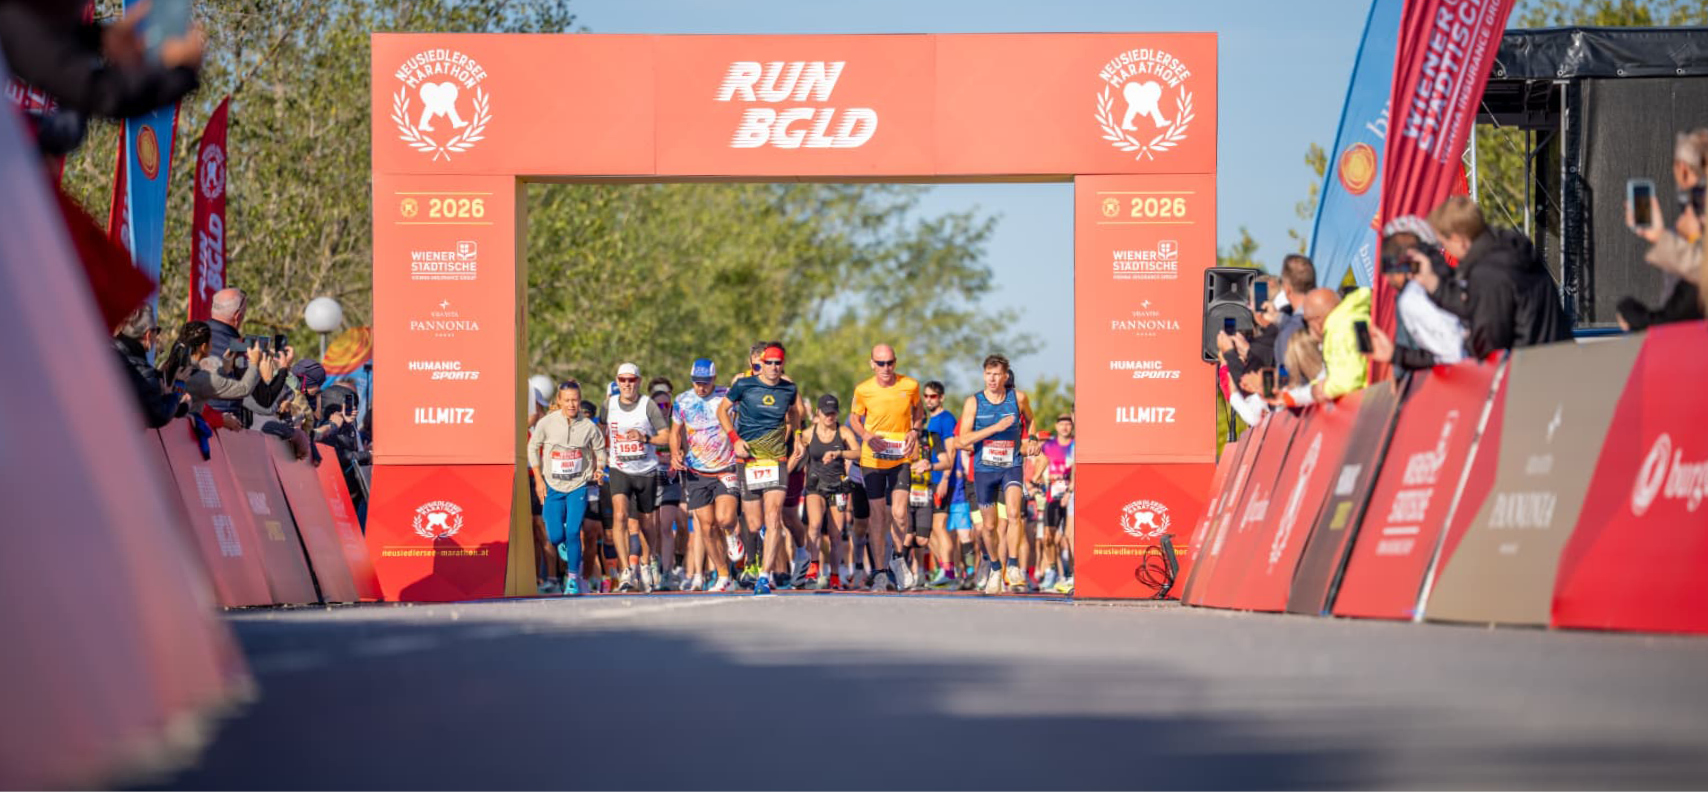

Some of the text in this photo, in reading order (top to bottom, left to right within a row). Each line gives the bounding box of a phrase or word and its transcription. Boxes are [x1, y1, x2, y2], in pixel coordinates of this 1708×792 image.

[395, 48, 488, 82] NEUSIEDLERSEE
[1099, 48, 1191, 82] NEUSIEDLERSEE
[1403, 5, 1453, 138] WIENER
[1457, 28, 1491, 111] INSURANCE
[406, 62, 477, 90] MARATHON
[712, 61, 846, 103] RUN
[1110, 61, 1180, 88] MARATHON
[728, 107, 879, 149] BGLD
[429, 198, 485, 218] 2026
[1130, 197, 1186, 218] 2026
[207, 213, 223, 292] BGLD
[411, 251, 455, 261] WIENER
[1112, 250, 1157, 260] WIENER
[411, 261, 477, 272] STÄDTISCHE
[1112, 260, 1178, 271] STÄDTISCHE
[410, 320, 479, 331] PANNONIA
[1111, 320, 1180, 331] PANNONIA
[408, 361, 461, 370] HUMANIC
[1110, 360, 1162, 370] HUMANIC
[431, 371, 480, 380] SPORTS
[1132, 370, 1181, 379] SPORTS
[414, 407, 475, 424] ILLMITZ
[1116, 406, 1176, 423] ILLMITZ
[382, 548, 490, 557] neusiedlersee-marathon.at
